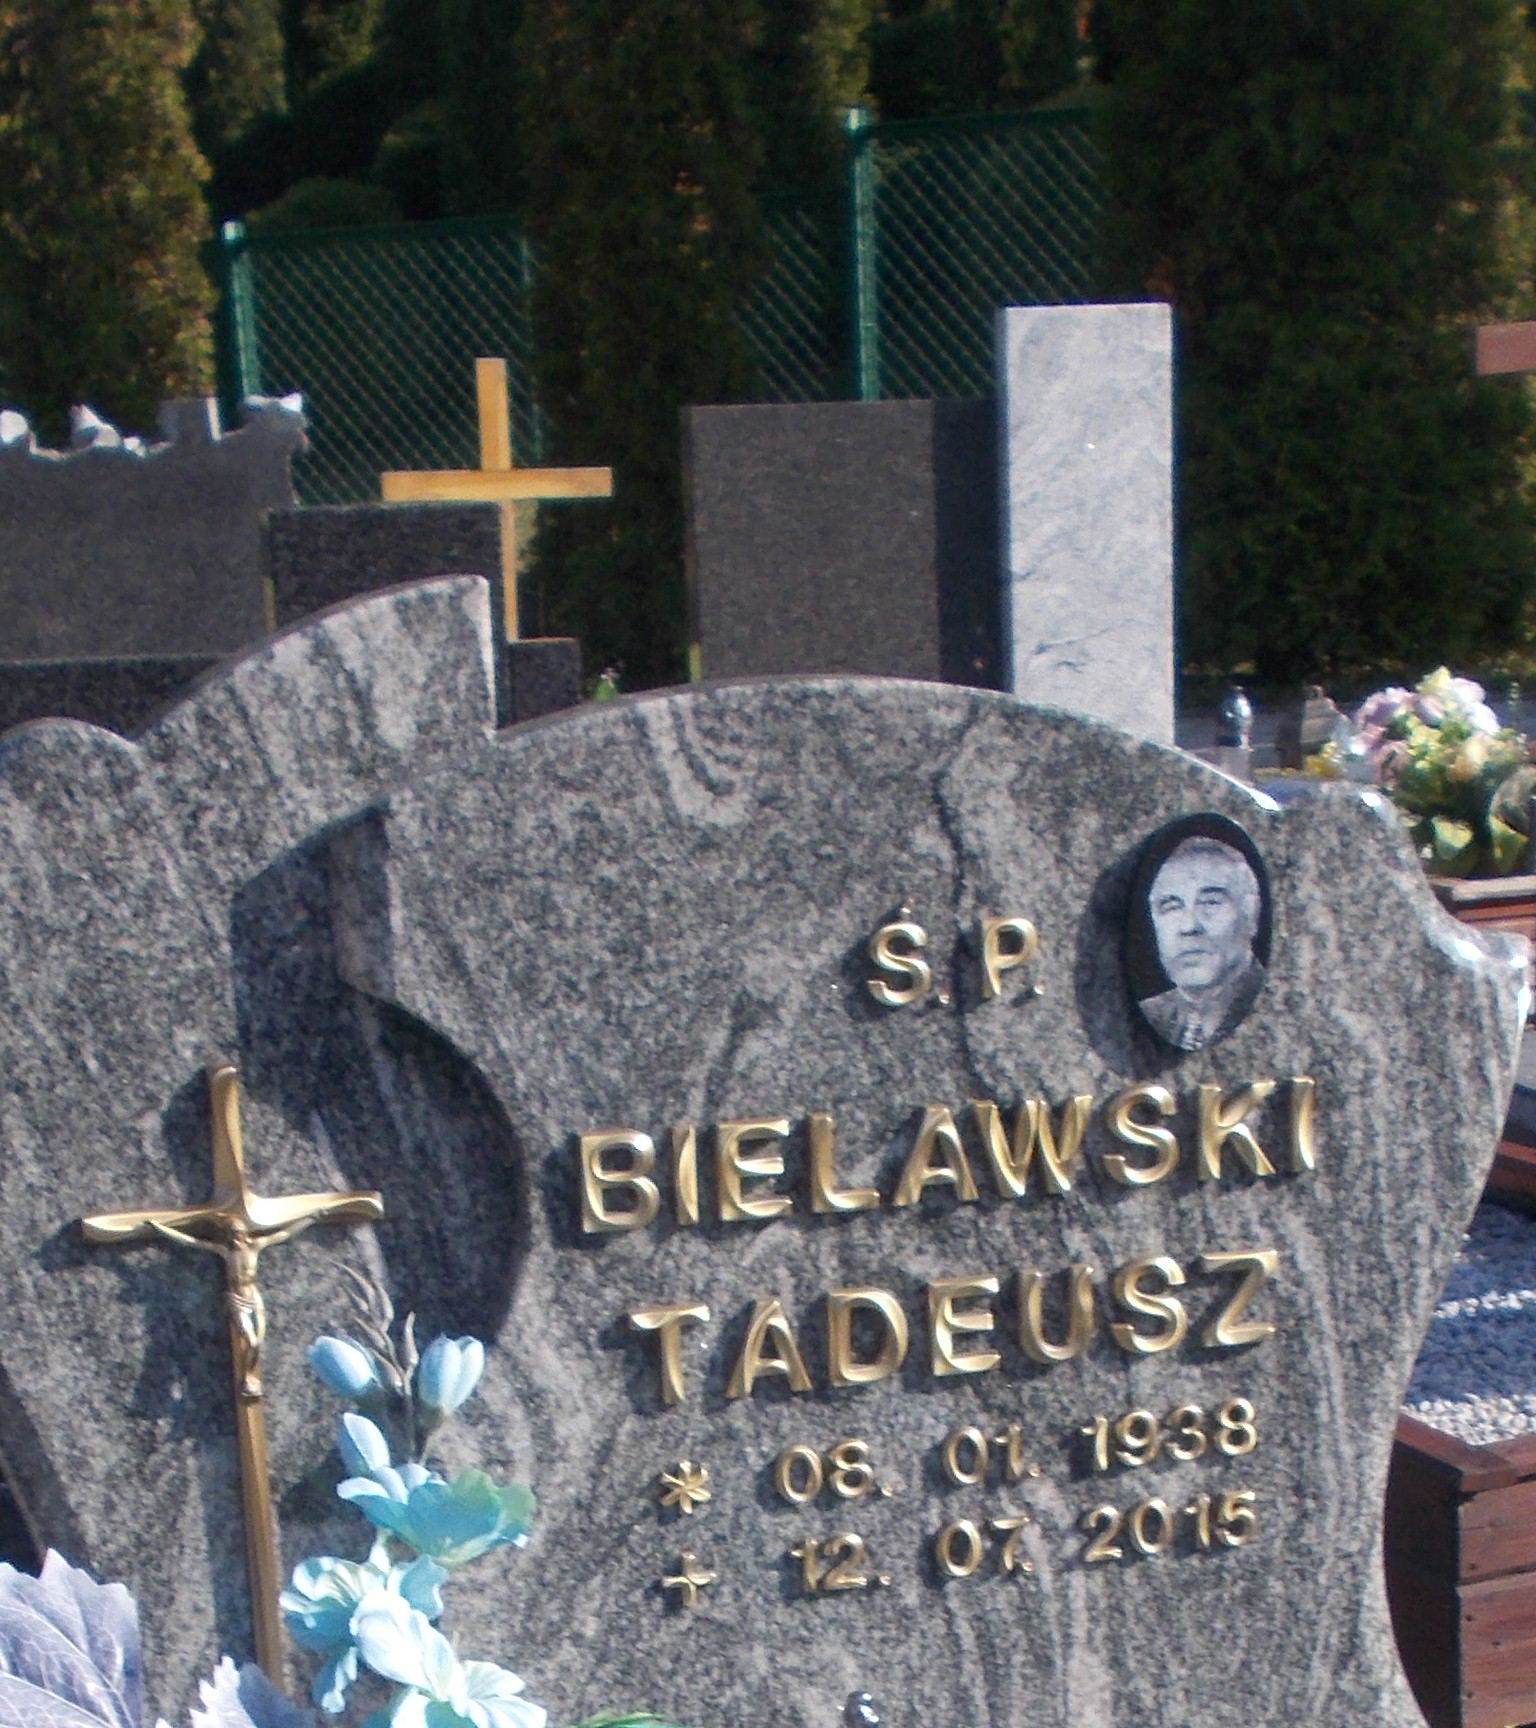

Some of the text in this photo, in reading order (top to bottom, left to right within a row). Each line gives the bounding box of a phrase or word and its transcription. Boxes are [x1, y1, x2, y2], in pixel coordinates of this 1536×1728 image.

[581, 1077, 1315, 1233] BIELAWSKI
[630, 1249, 1278, 1403] TADEUSZ
[776, 1398, 1258, 1502] 08. 01. 1938
[789, 1490, 1256, 1593] 12. 07. 2015
